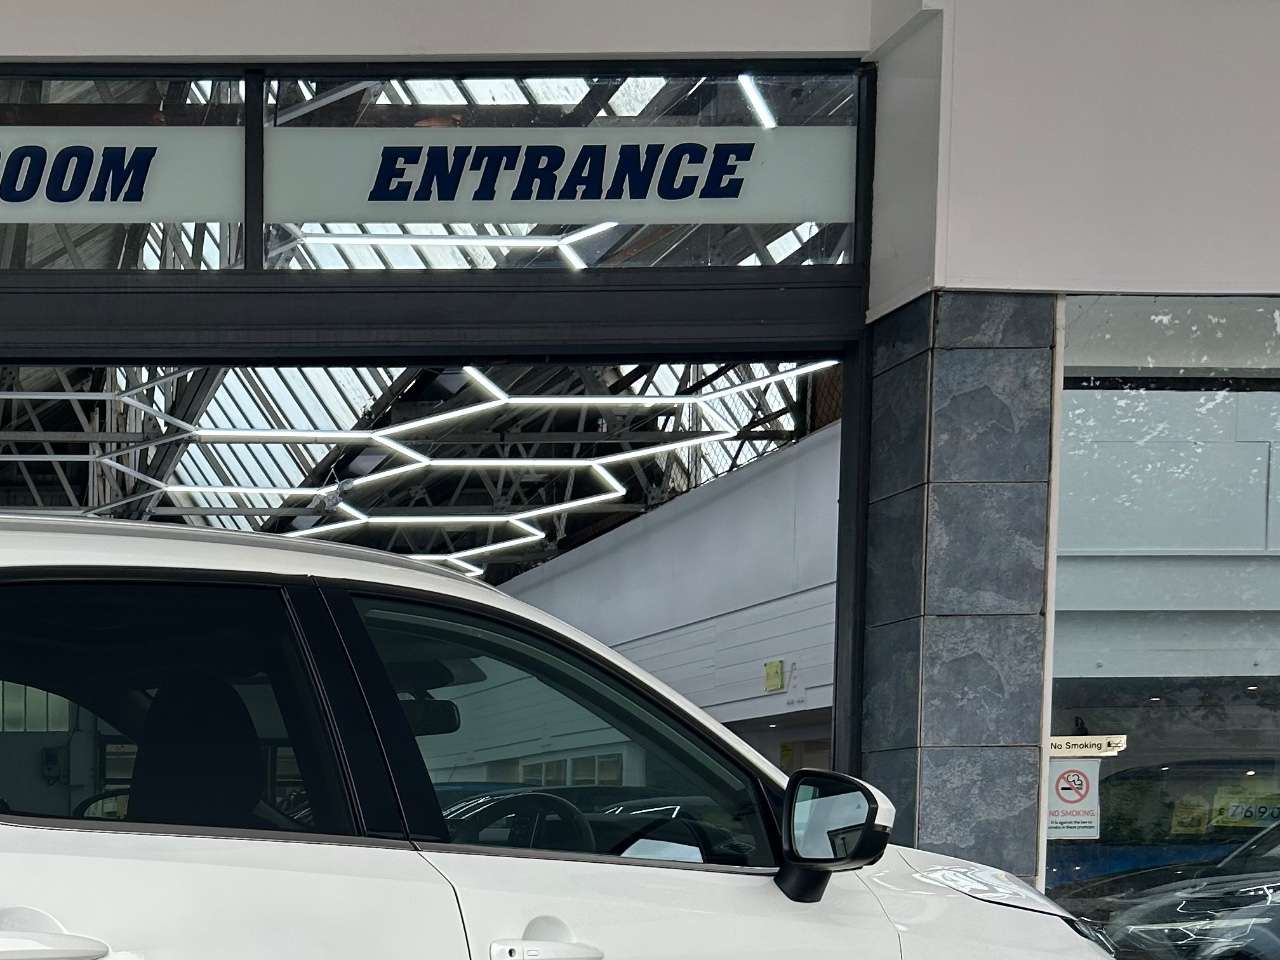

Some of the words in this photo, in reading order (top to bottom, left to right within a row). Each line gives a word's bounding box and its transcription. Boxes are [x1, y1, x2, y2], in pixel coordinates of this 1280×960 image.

[367, 142, 756, 202] ENTRANCE
[1050, 742, 1063, 750] No
[1065, 741, 1102, 751] Smoking
